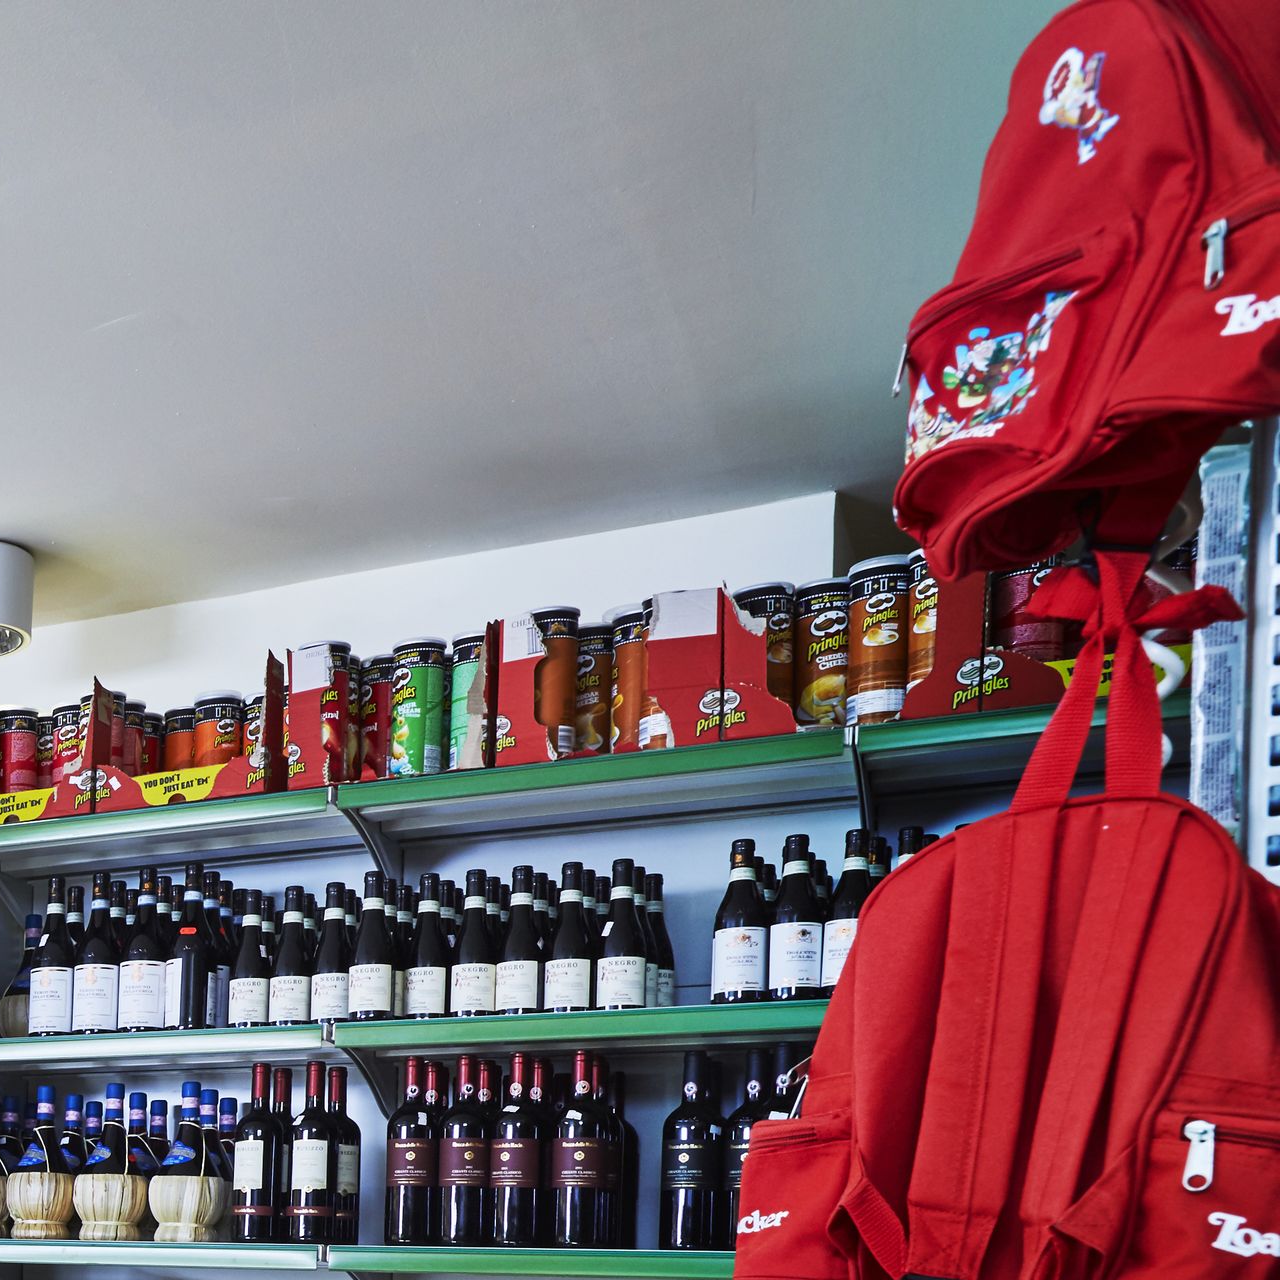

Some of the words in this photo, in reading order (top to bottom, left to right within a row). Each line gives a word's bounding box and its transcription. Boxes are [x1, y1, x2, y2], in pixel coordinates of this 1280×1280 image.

[862, 607, 899, 632] Pringles
[143, 779, 158, 789] YOU
[163, 783, 180, 795] JUST
[181, 780, 194, 791] EAT
[0, 804, 15, 815] JUST
[16, 801, 28, 812] EAT
[355, 966, 380, 974] NEGRO
[408, 968, 434, 977] NEGRO
[461, 966, 489, 974] NEGRO
[236, 979, 261, 988] NEGRO
[320, 975, 345, 983] NEGRO
